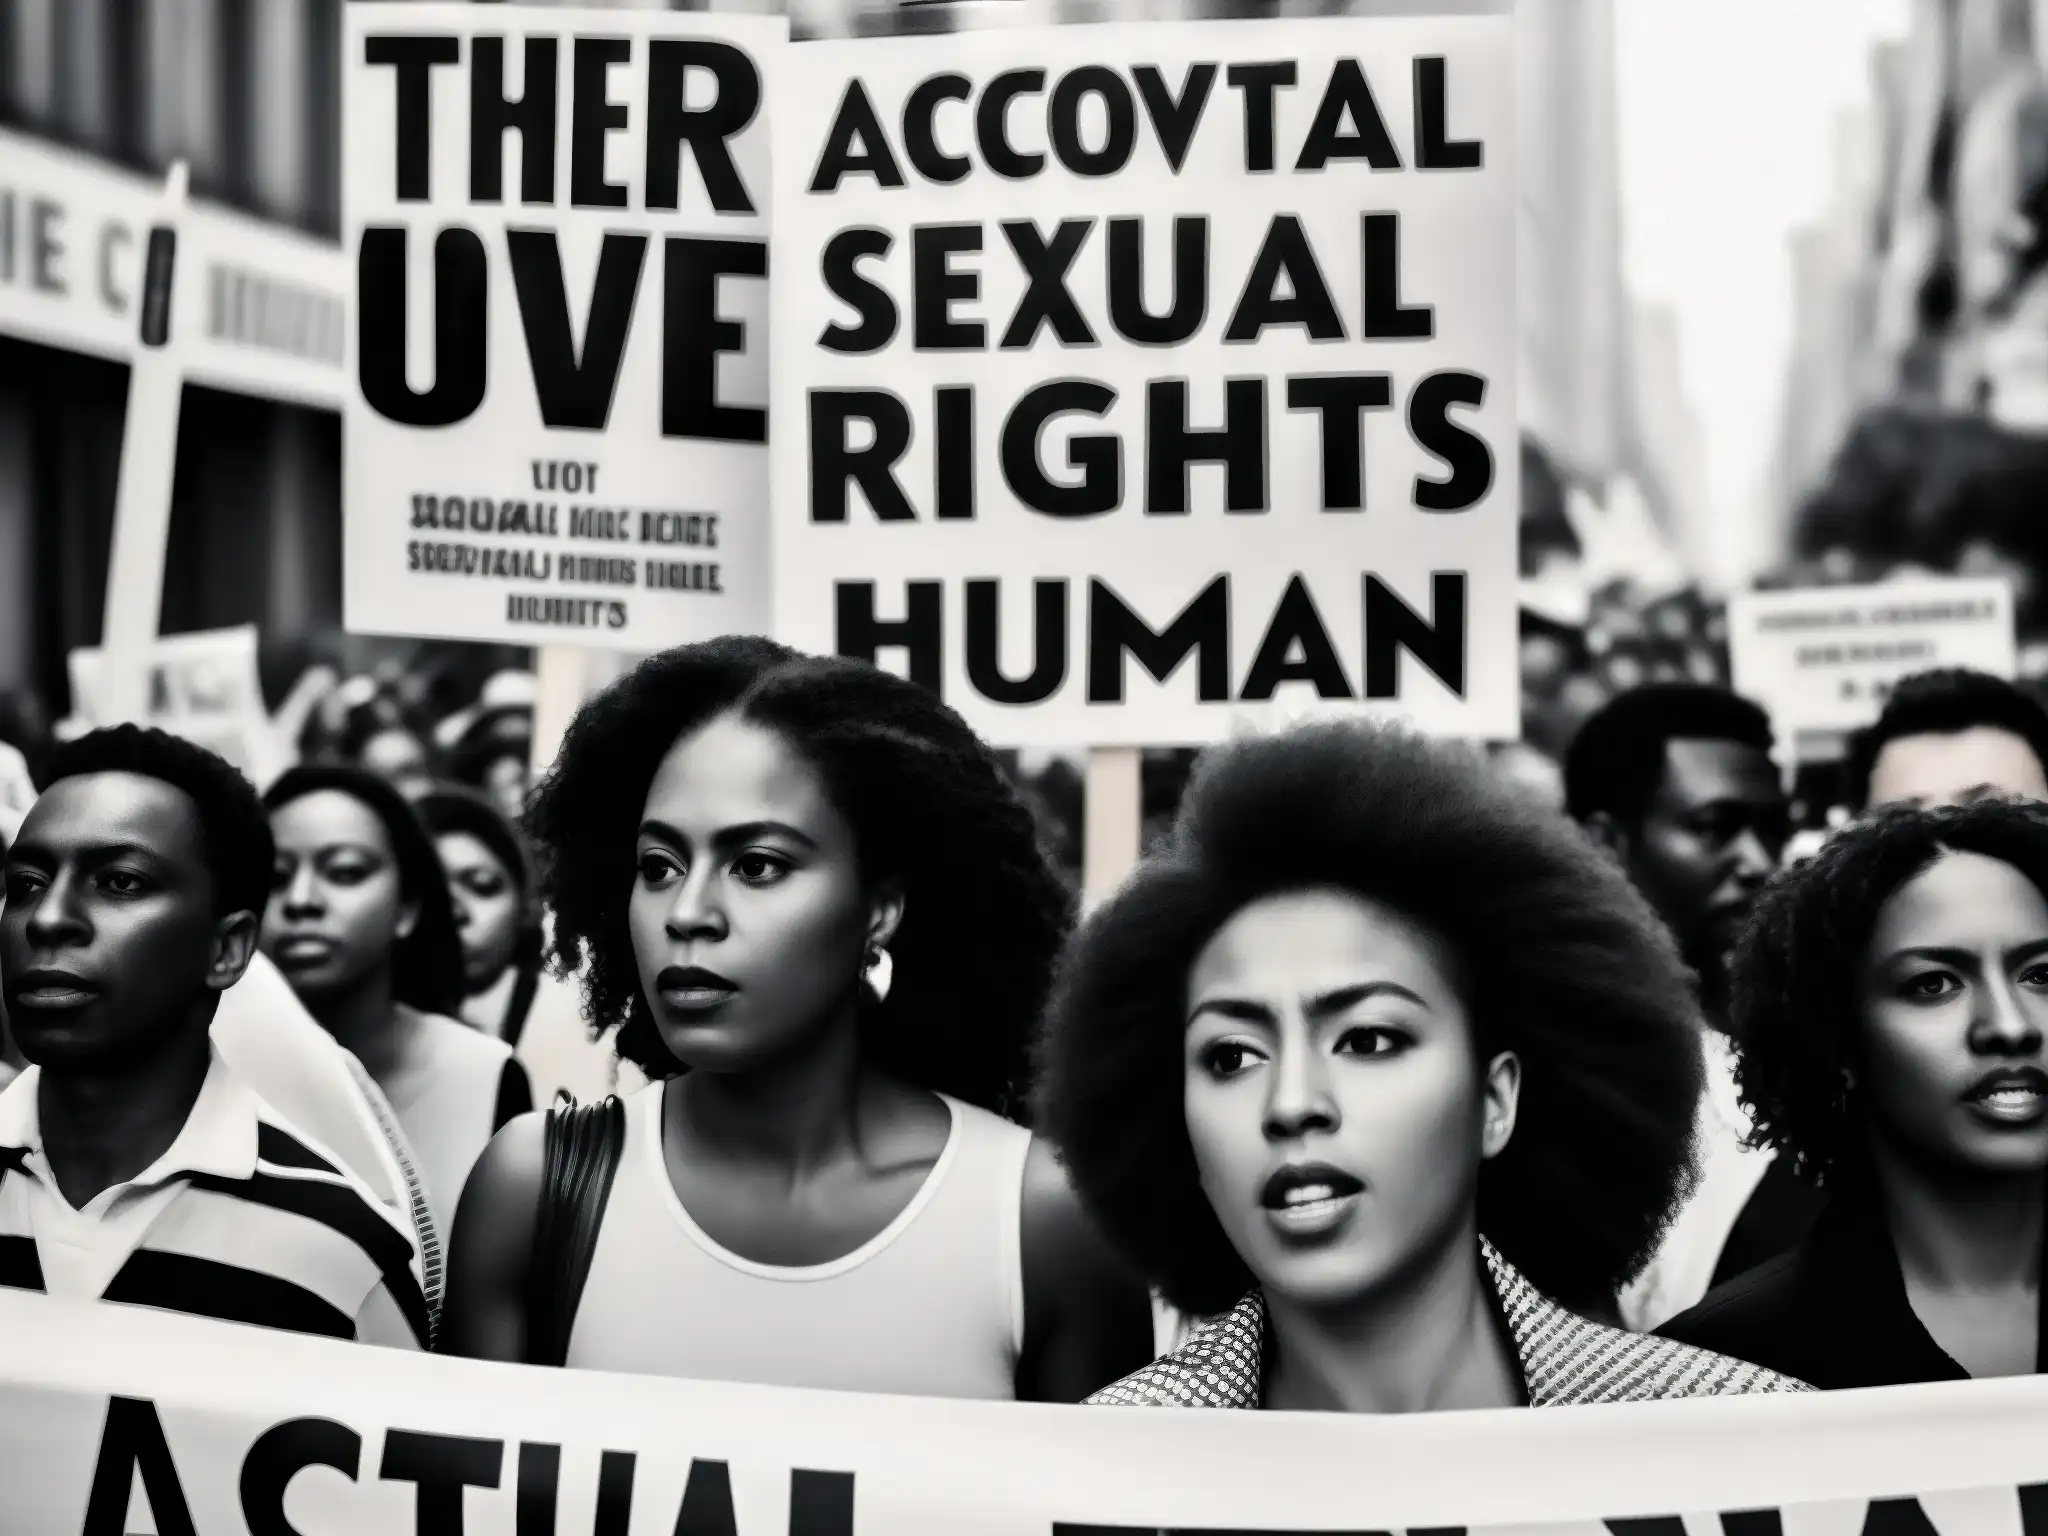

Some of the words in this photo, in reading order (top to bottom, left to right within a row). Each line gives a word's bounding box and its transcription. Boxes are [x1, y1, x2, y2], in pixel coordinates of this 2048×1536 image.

[363, 34, 762, 215] THER
[808, 55, 1484, 194] ACCOVTAL
[357, 225, 770, 446] UVE
[816, 212, 1436, 354] SEXUAL
[807, 370, 1496, 524] RIGHTS
[834, 570, 1468, 705] HUMAN
